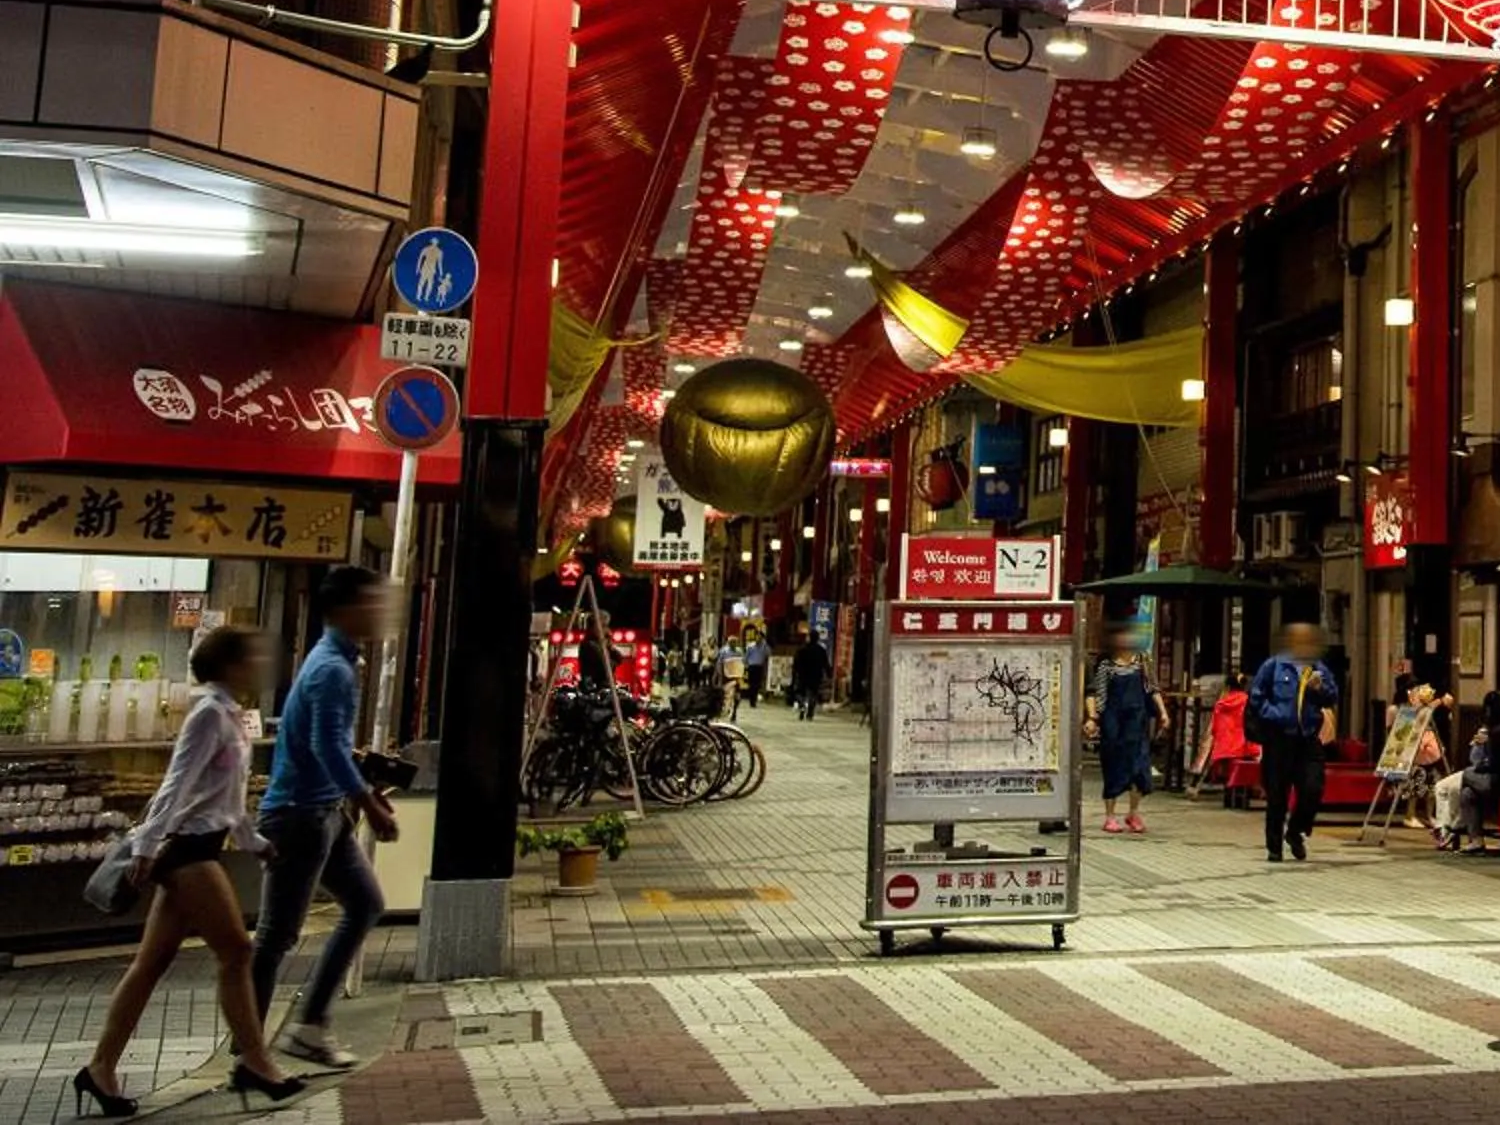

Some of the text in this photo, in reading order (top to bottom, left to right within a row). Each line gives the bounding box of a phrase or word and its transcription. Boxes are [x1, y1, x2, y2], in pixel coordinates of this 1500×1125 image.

[923, 549, 988, 565] Welcome
[998, 547, 1048, 570] N-2
[953, 568, 992, 585] 欢迎
[935, 867, 1066, 890] 車両進入禁止
